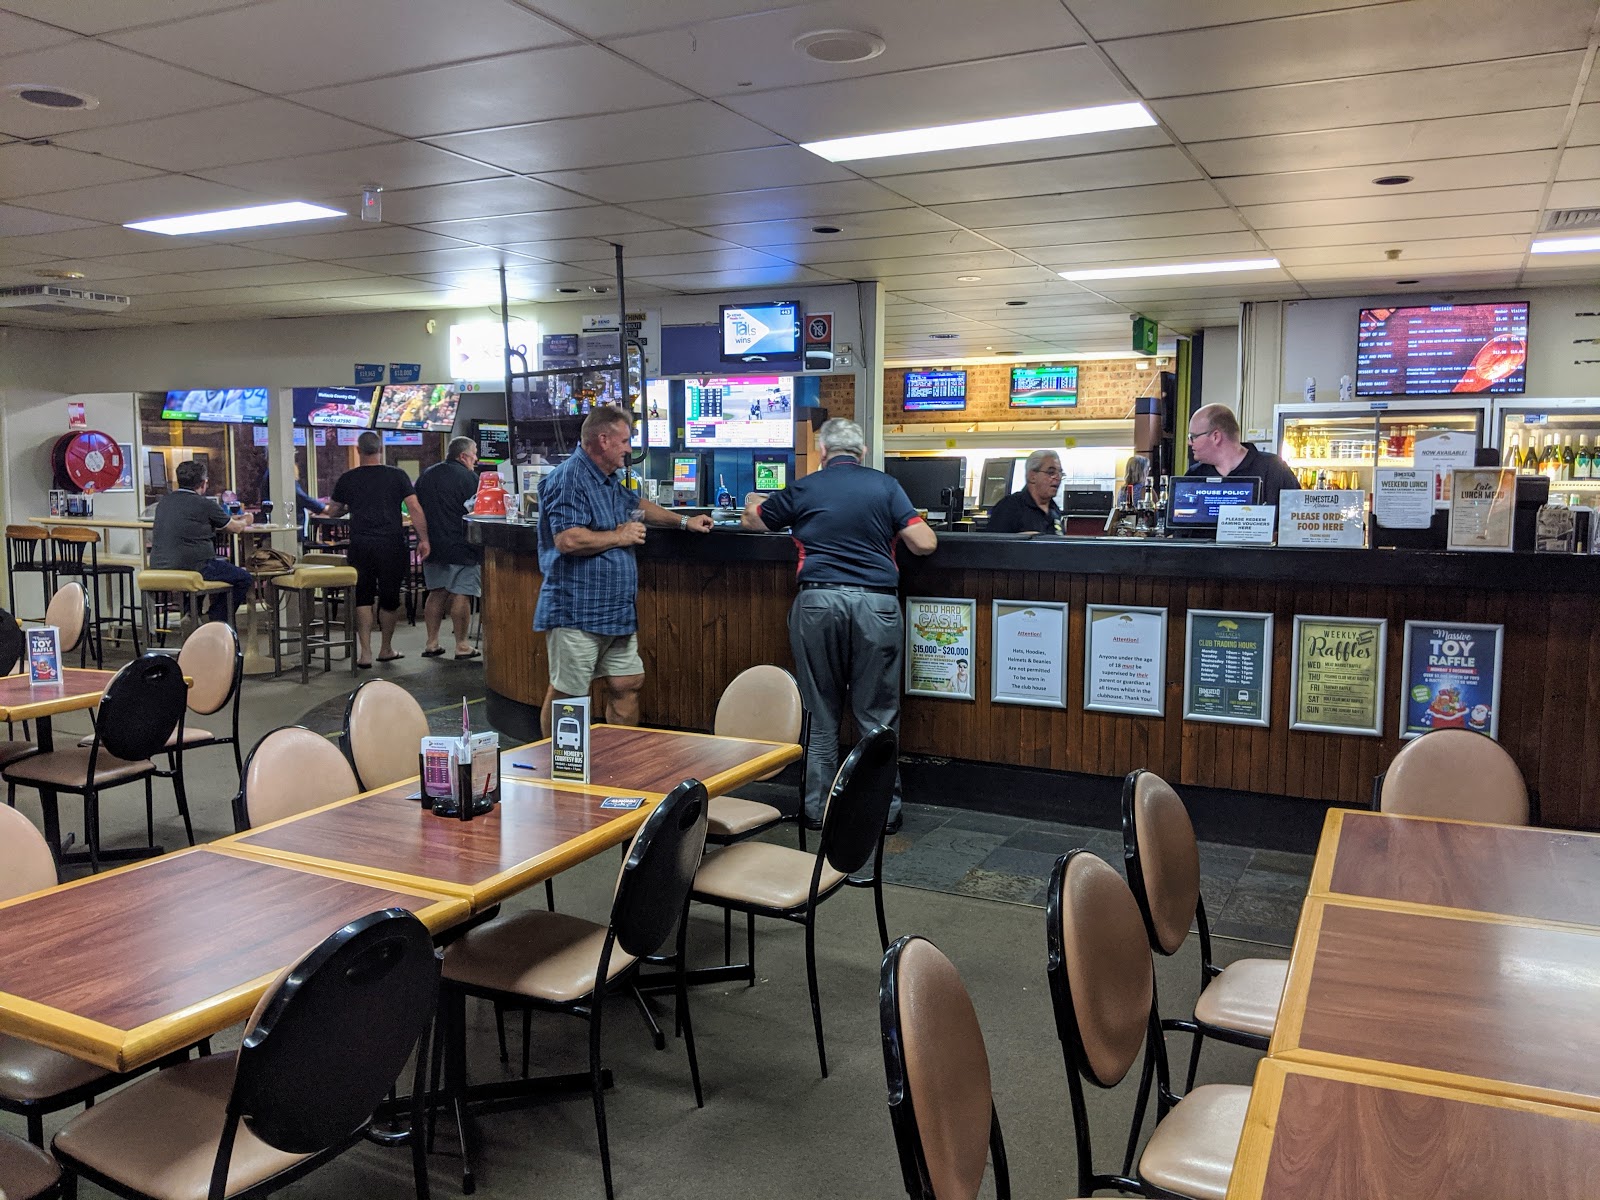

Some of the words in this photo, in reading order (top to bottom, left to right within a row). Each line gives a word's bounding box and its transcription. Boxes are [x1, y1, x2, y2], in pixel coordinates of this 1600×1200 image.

[1304, 494, 1339, 504] HOMESTEAD
[1291, 512, 1320, 520] PLEASE
[1323, 523, 1344, 531] HERE
[920, 605, 938, 613] COLD
[941, 606, 961, 614] HARD
[919, 614, 962, 628] CASH
[1324, 630, 1356, 639] WEEKLY
[1433, 629, 1472, 640] Massive
[32, 641, 52, 650] TOY
[1214, 640, 1237, 648] TRADING
[1308, 636, 1371, 661] Raffles
[1430, 640, 1475, 656] TOY
[913, 645, 937, 654] $15,000
[943, 647, 969, 656] $20,000
[1307, 661, 1321, 669] WED
[1429, 656, 1475, 667] RAFFLE
